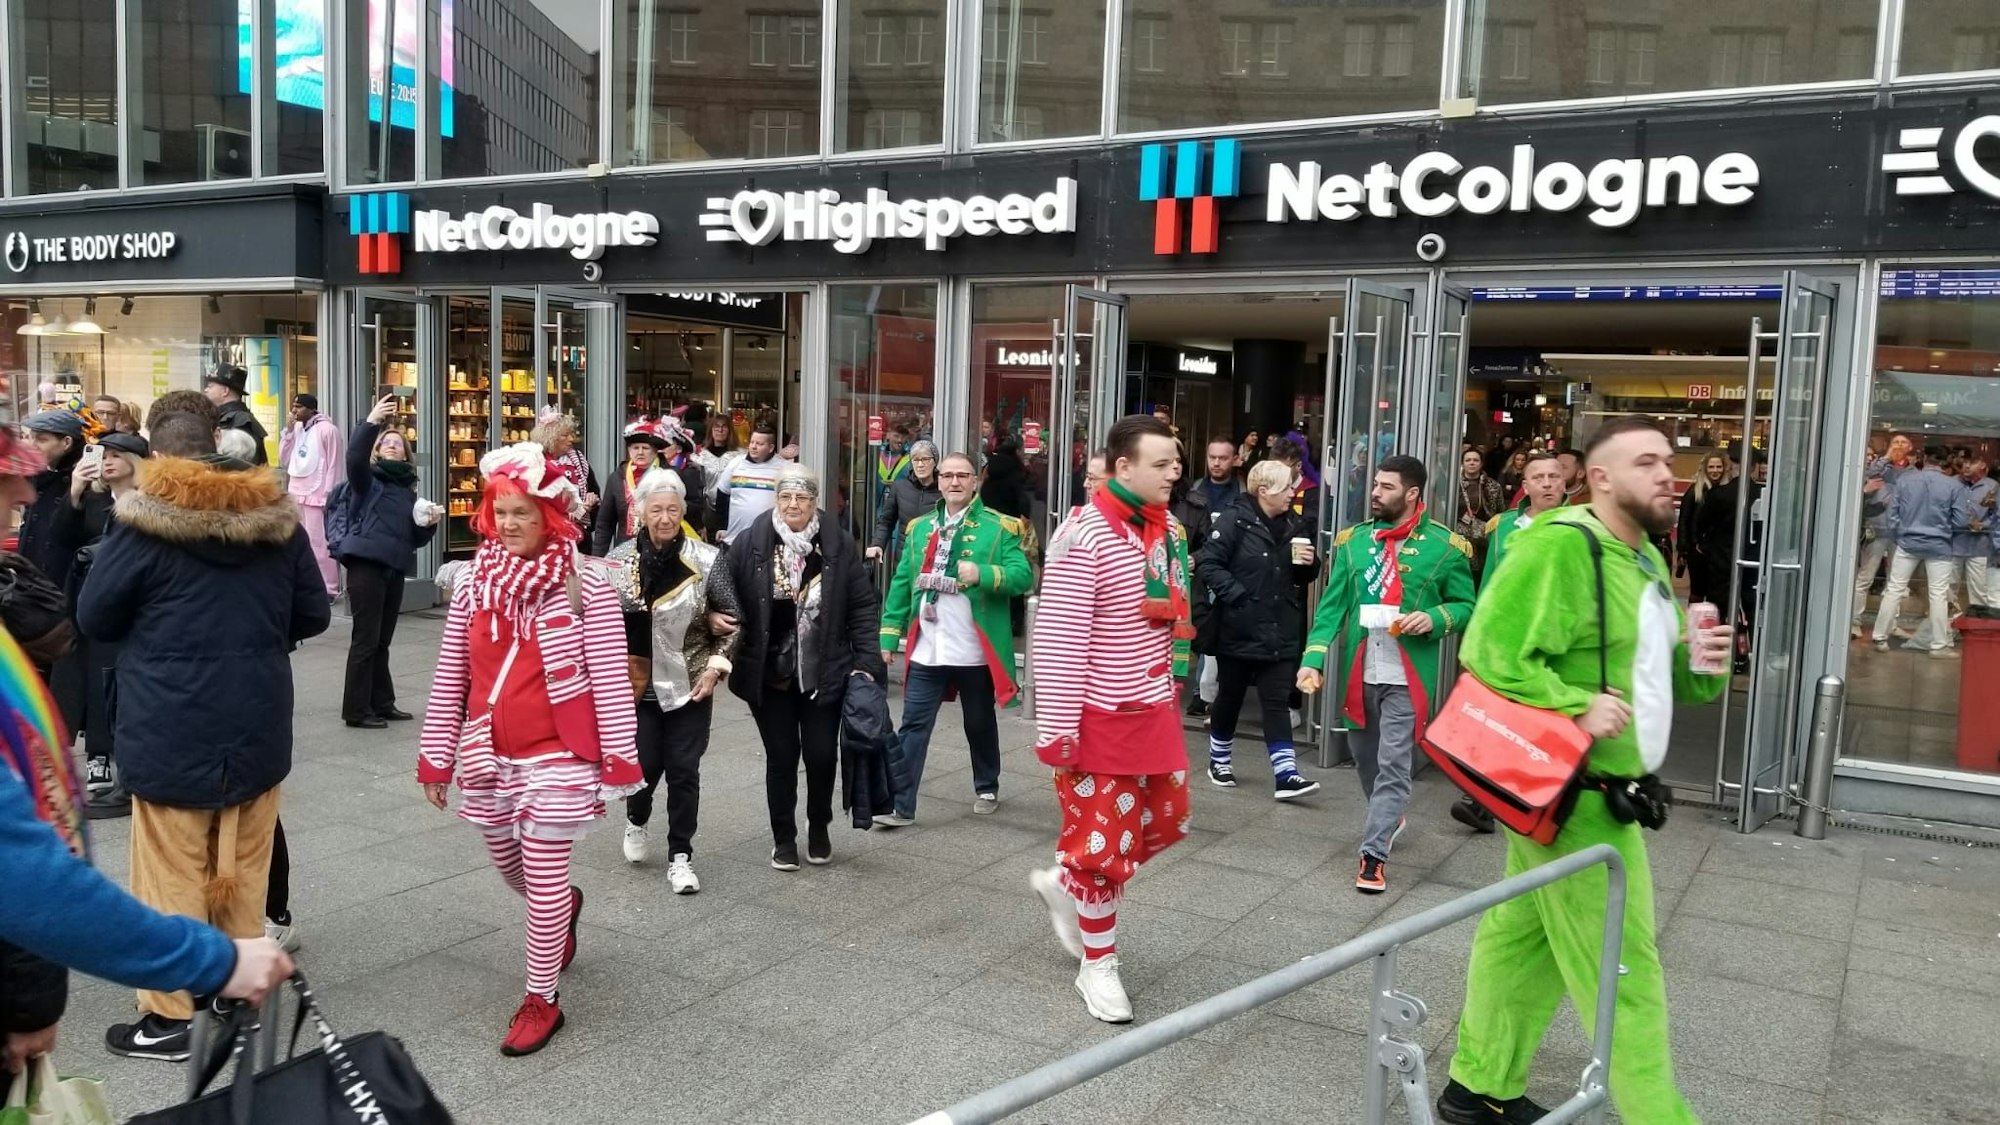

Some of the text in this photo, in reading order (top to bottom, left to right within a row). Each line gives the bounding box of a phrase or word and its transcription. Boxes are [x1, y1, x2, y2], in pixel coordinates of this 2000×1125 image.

[1266, 144, 1760, 228] NetCologne
[414, 202, 660, 260] NetCologne
[783, 176, 1078, 255] Highspeed
[33, 231, 176, 262] THE BODY SHOP
[998, 347, 1080, 366] Leonis
[1689, 385, 1711, 399] DB
